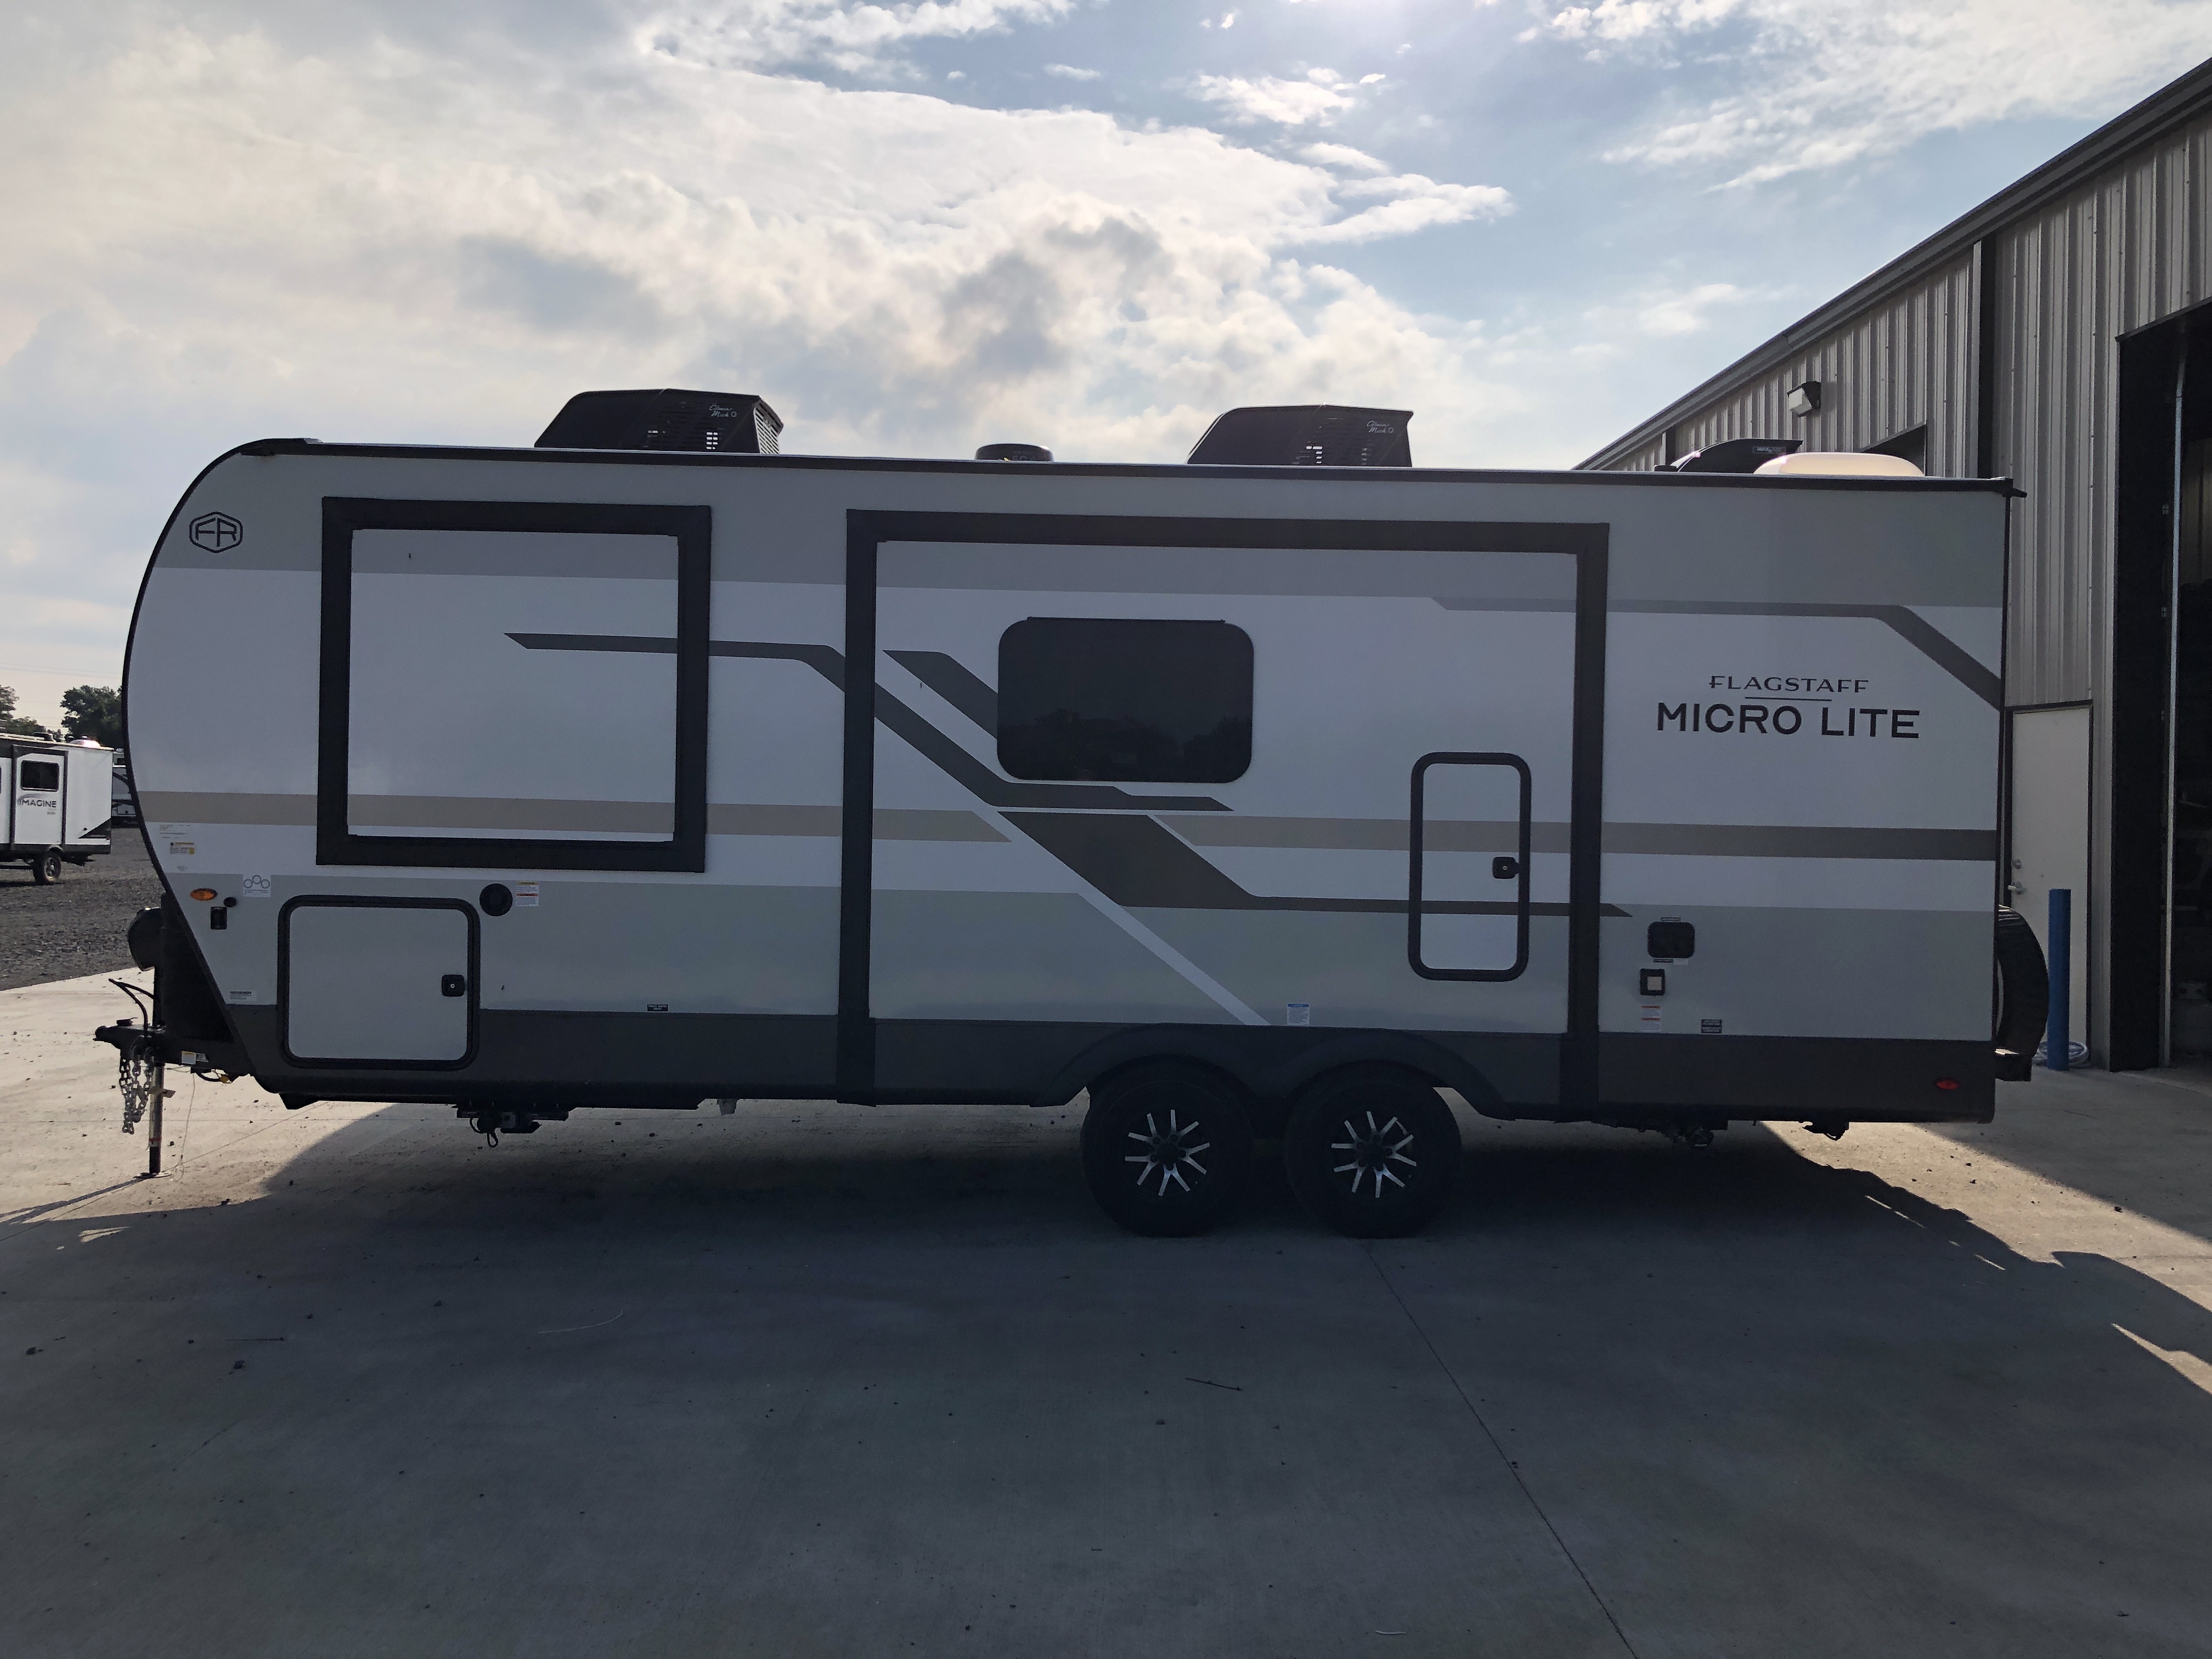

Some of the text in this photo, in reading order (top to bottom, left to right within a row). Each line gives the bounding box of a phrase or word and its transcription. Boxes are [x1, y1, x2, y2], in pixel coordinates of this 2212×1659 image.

[1709, 675, 1869, 693] FLAGSTAFF
[1657, 702, 1920, 739] MICRO LITE
[19, 799, 57, 808] IMAGINE
